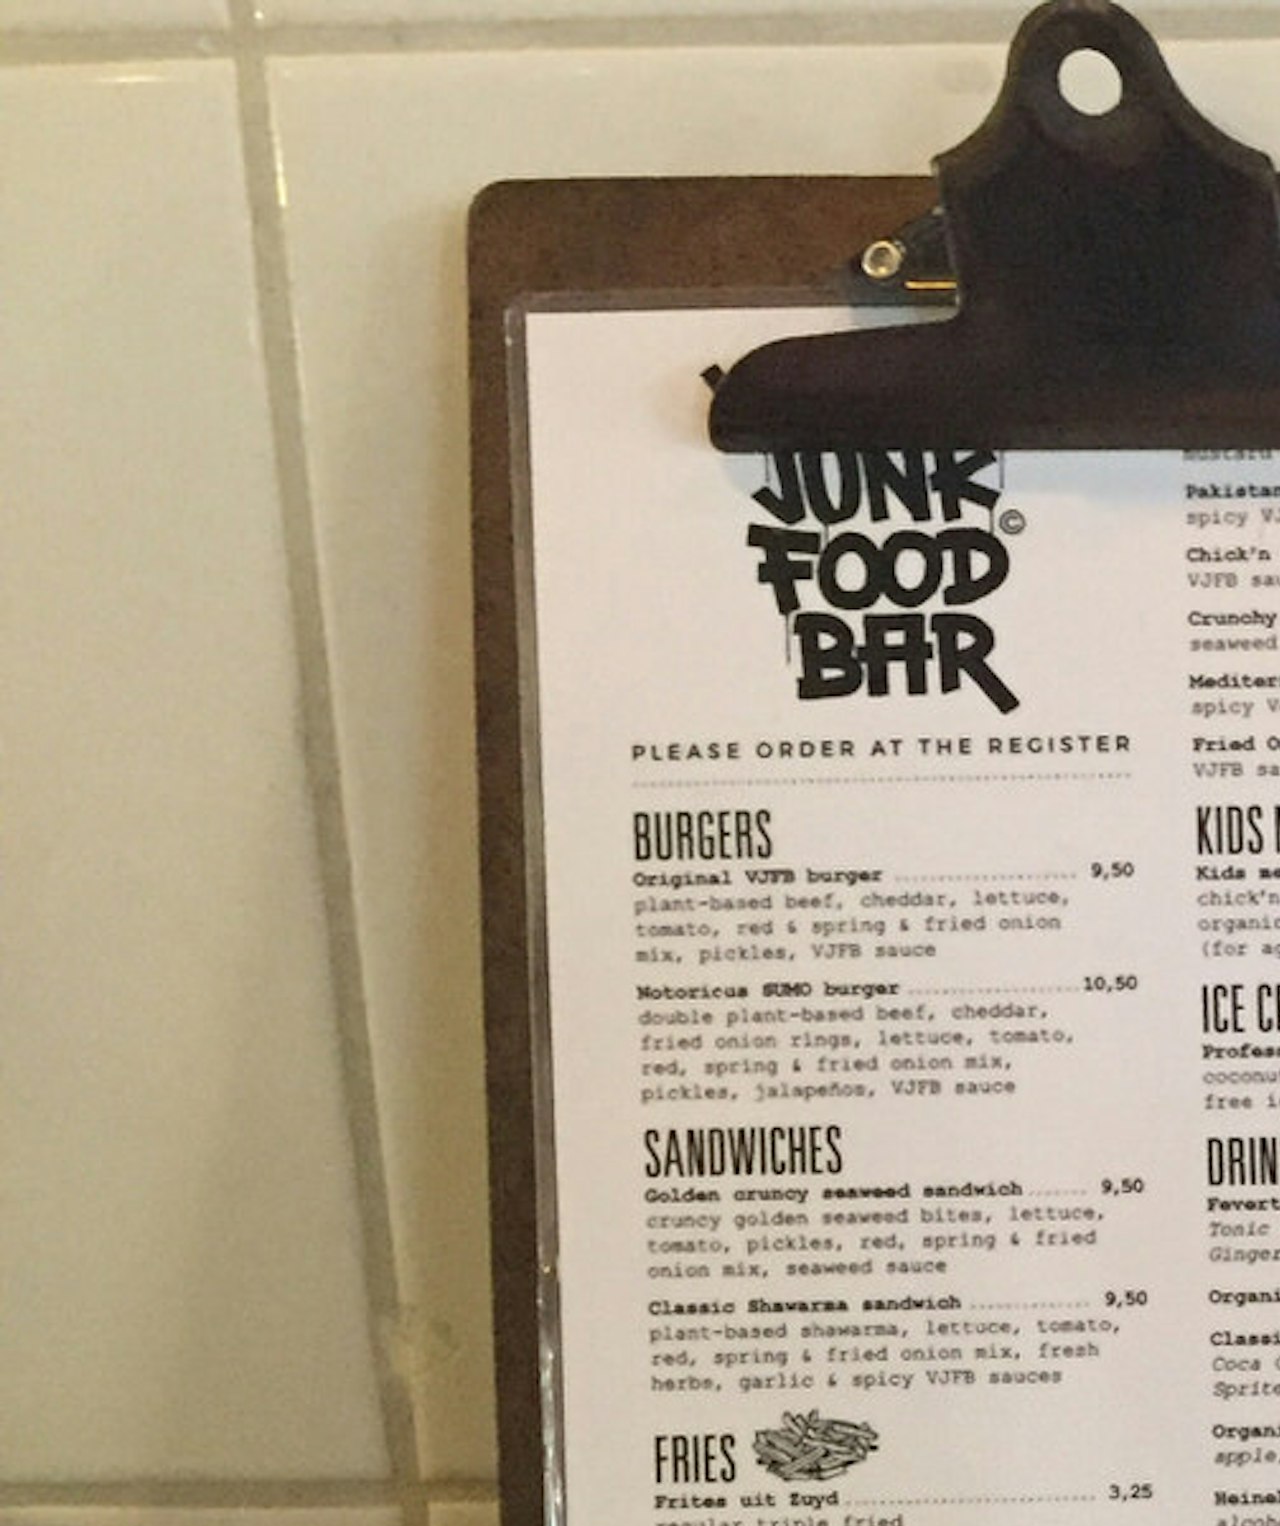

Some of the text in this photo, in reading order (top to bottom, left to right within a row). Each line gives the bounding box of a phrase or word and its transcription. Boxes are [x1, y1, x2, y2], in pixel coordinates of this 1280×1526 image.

[751, 449, 1001, 524] JUNK
[747, 524, 1010, 616] FOOD
[1186, 609, 1278, 628] Crunchy
[793, 612, 1020, 715] BAR
[632, 735, 1132, 762] PLEASE ORDER AT THE REGISTER
[1192, 734, 1257, 750] Fried
[633, 809, 772, 861] BURGERS
[1196, 804, 1265, 856] KIDS
[631, 869, 733, 890] Original
[805, 867, 883, 886] burger
[1091, 861, 1135, 881] 9,50
[1195, 863, 1247, 880] Kids
[822, 980, 901, 999] burger
[1084, 974, 1138, 994] 10,50
[1202, 983, 1245, 1035] ICE
[644, 1124, 843, 1178] SANDWICHES
[643, 1186, 722, 1203] Golden
[821, 1182, 912, 1199] seaweed
[922, 1180, 1024, 1197] sandwich
[1101, 1177, 1145, 1197] 9,50
[647, 1290, 1148, 1315] Classic Shawarma sandwich 9,50
[654, 1434, 737, 1484] FRIES
[653, 1492, 728, 1508] Frites
[739, 1491, 777, 1507] uit
[1108, 1483, 1154, 1502] 3,25
